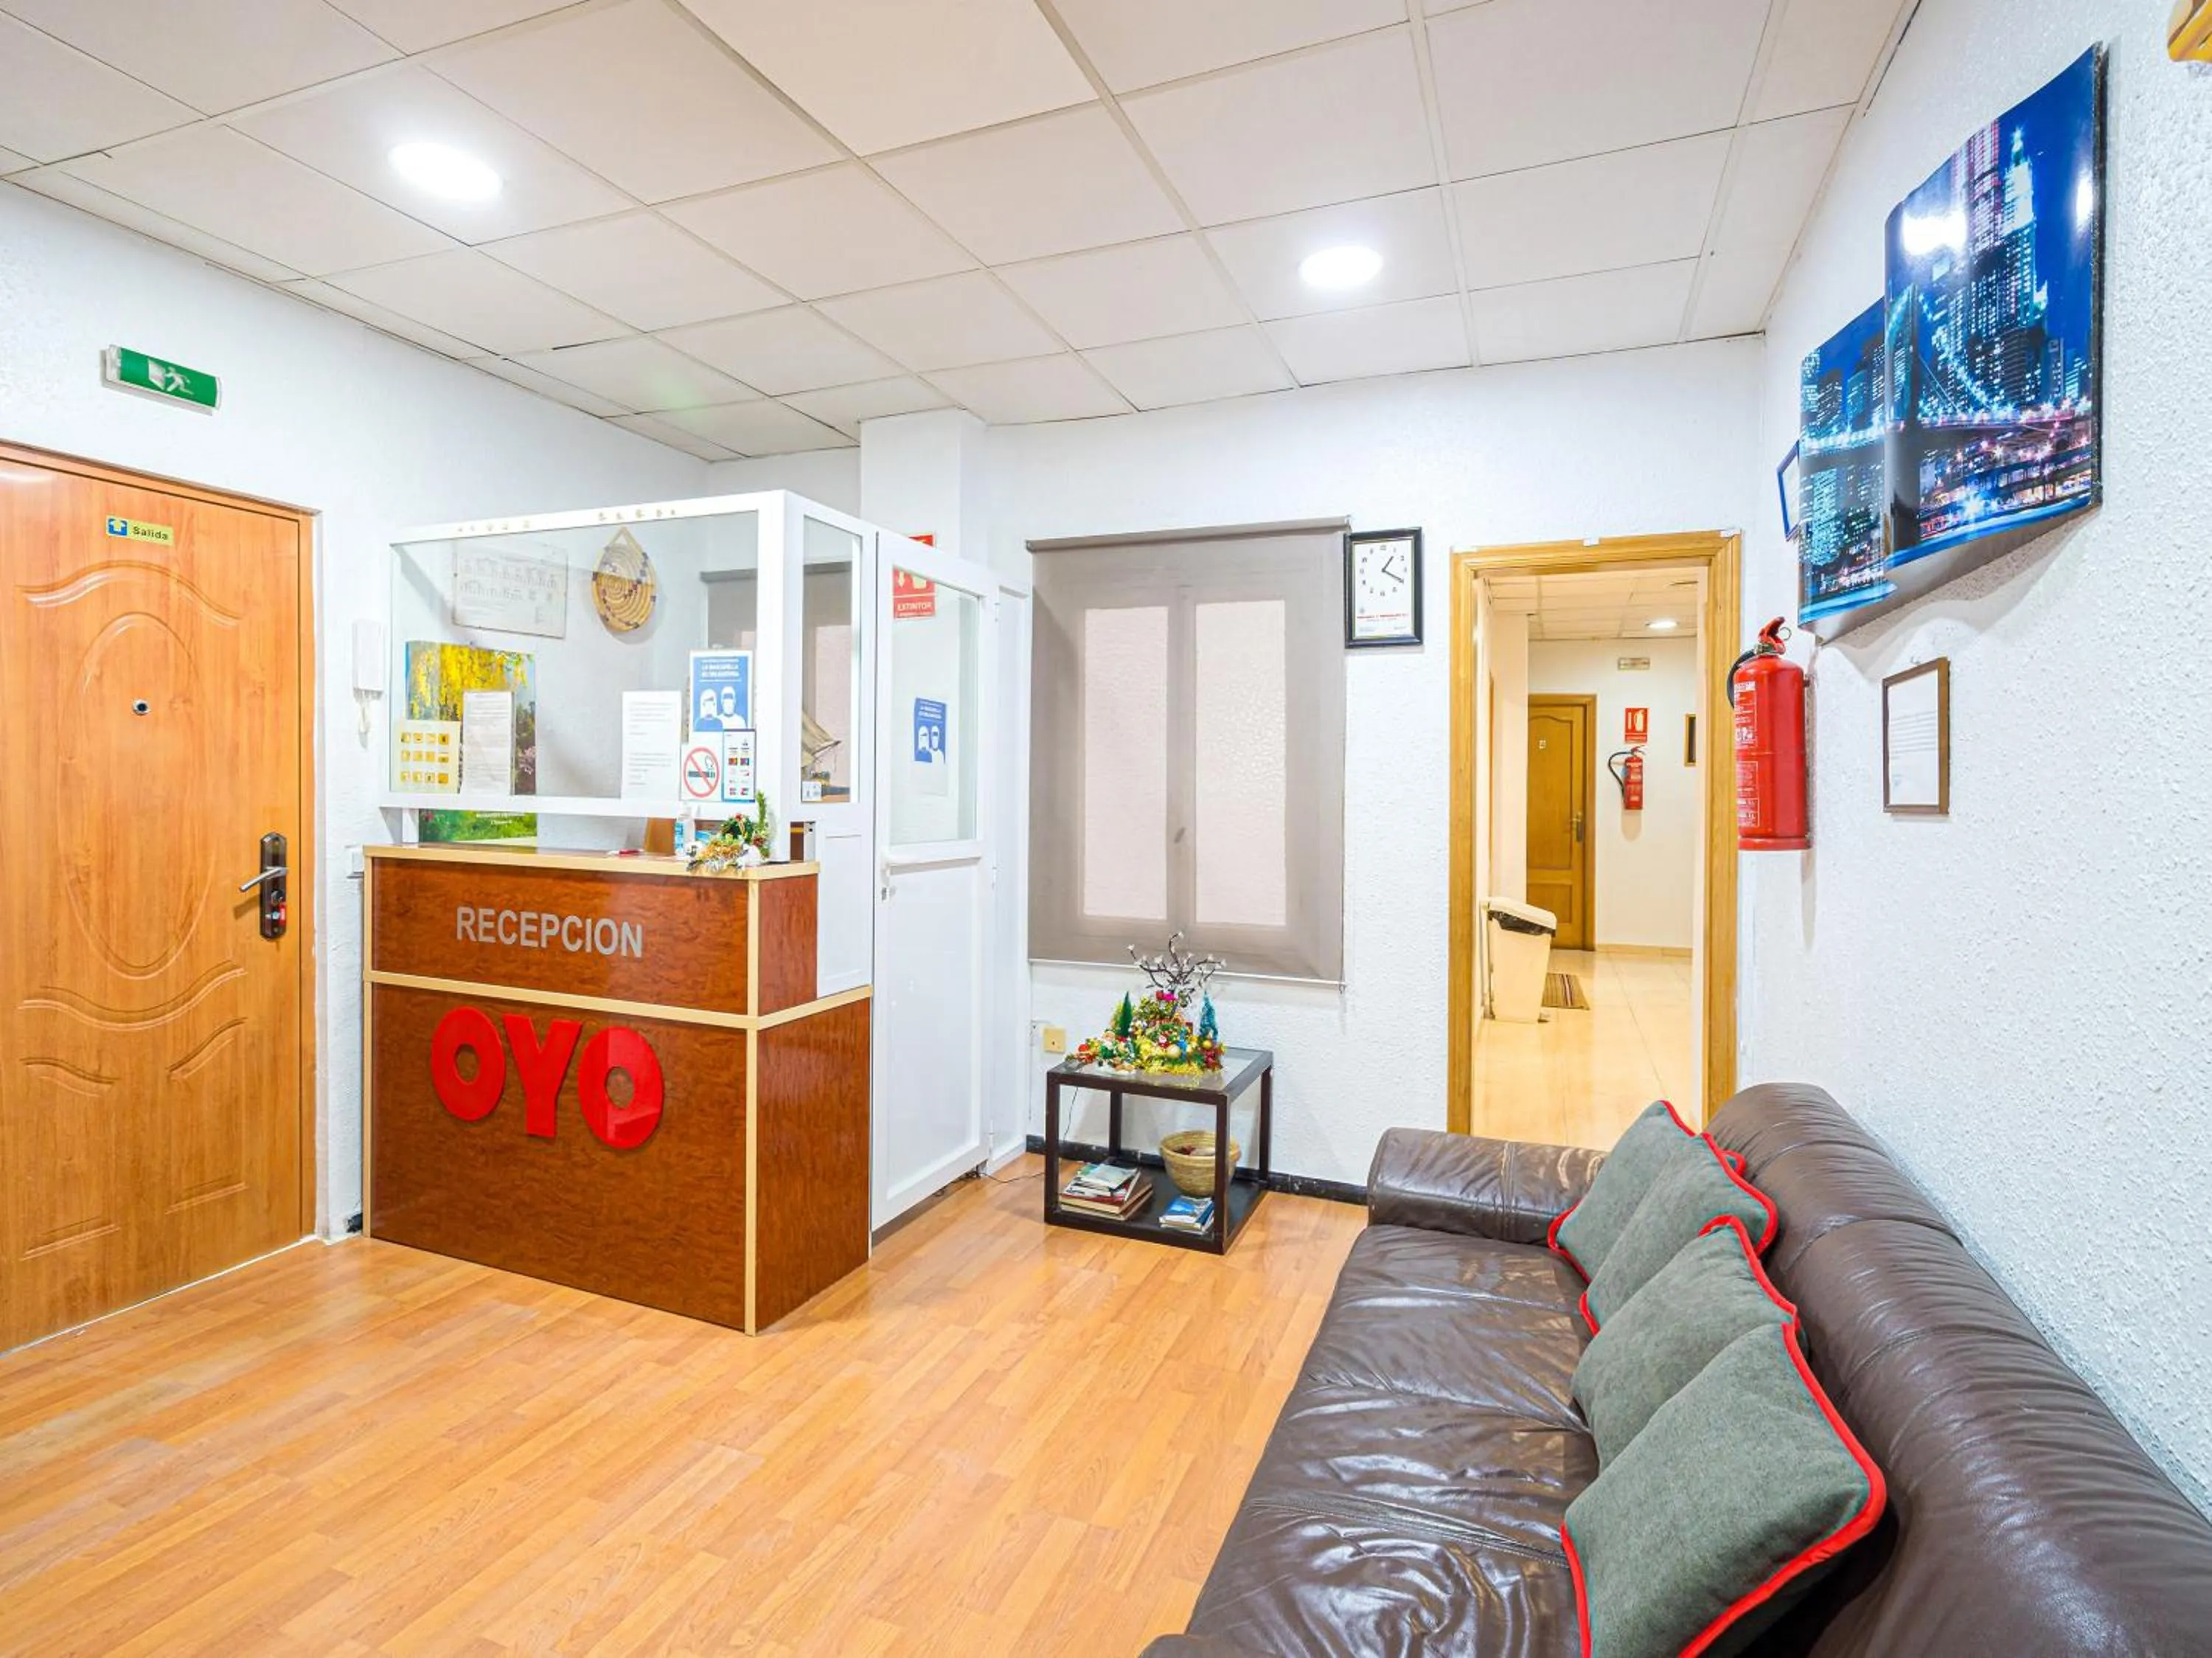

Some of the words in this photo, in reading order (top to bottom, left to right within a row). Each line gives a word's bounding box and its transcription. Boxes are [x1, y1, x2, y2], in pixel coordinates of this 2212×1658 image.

[133, 525, 169, 541] Salida
[897, 601, 932, 611] EXTINTOR
[456, 906, 643, 958] RECEPCION
[431, 1006, 664, 1150] OYO
